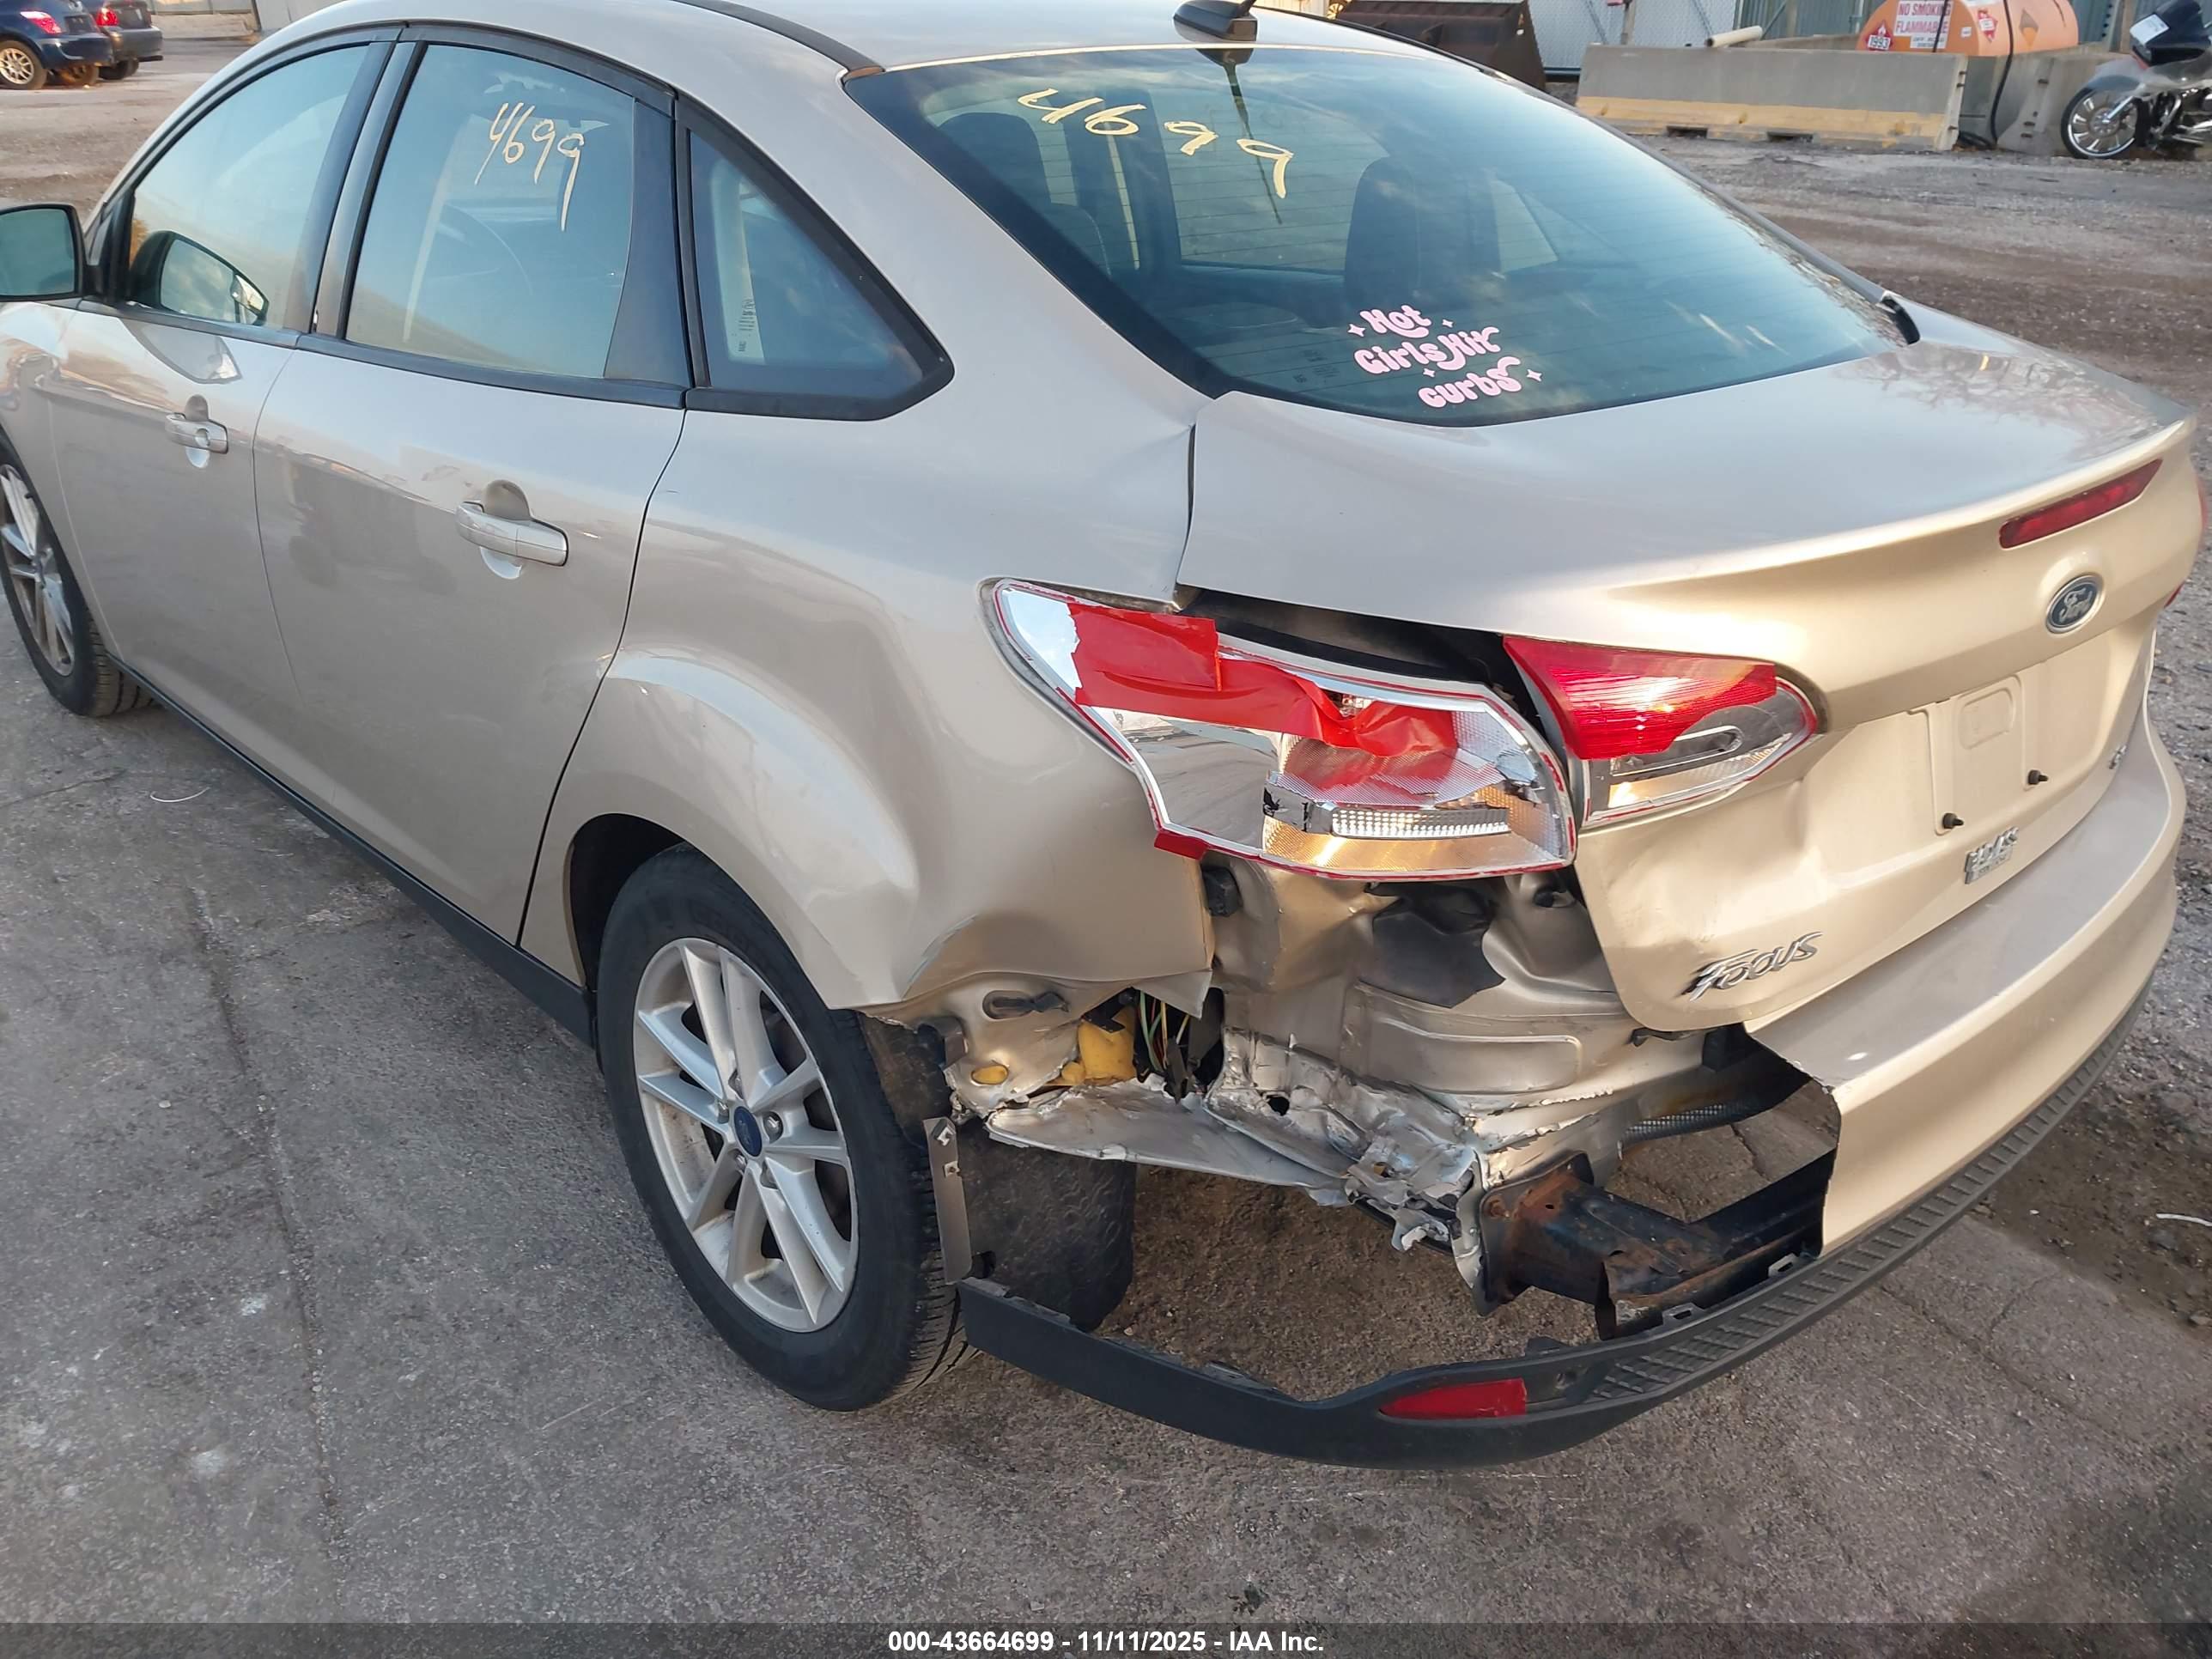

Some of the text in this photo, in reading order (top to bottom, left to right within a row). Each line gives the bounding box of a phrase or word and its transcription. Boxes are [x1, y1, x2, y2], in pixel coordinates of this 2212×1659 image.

[1898, 3, 1911, 15] NO
[1869, 36, 1889, 49] 1993
[1896, 21, 1948, 33] FLAMMABE
[1018, 88, 1294, 199] 4699
[474, 102, 585, 232] 4699
[1359, 305, 1432, 338] Hot
[1354, 326, 1502, 374] Girls Hit
